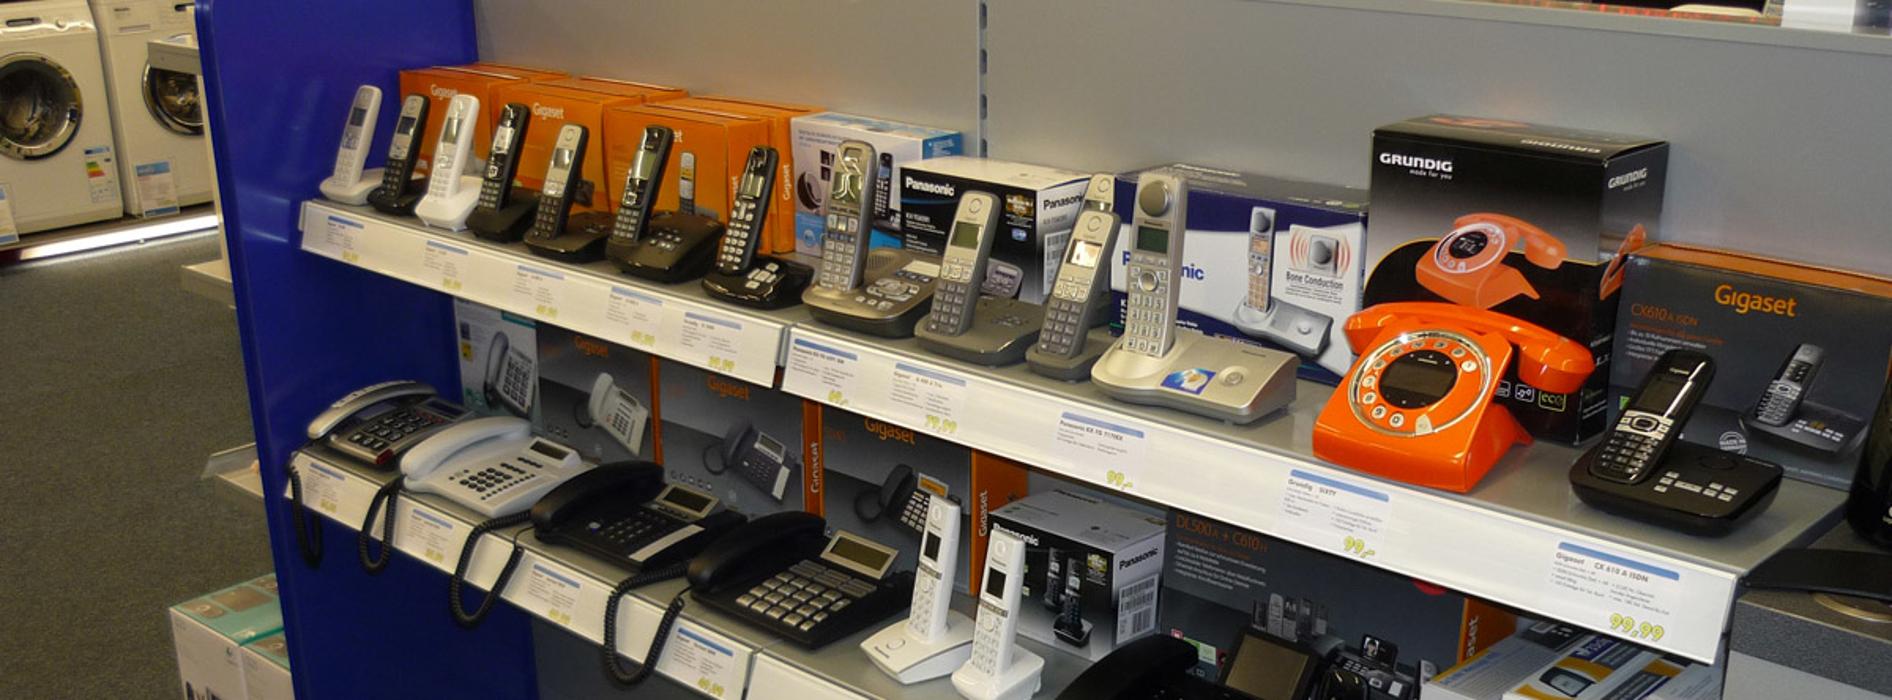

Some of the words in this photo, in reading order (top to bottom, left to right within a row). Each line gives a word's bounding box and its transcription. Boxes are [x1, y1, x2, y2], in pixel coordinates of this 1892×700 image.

[532, 102, 564, 120] Gigaset
[1379, 152, 1453, 172] GRUNDIG
[1409, 168, 1427, 177] made
[1427, 170, 1439, 178] for
[783, 164, 792, 200] Gigaset
[905, 176, 955, 197] Panasonic
[1608, 168, 1648, 189] GRUNDIG
[1286, 270, 1303, 284] Bone
[1304, 273, 1344, 290] Conduction
[1714, 283, 1797, 317] Gigaset
[707, 376, 750, 401] Gigaset
[864, 415, 916, 445] Gigaset
[810, 441, 819, 494] Gigaset
[1287, 478, 1313, 492] Grundig
[1319, 487, 1337, 497] SIXTY
[978, 489, 988, 538] Gigaset
[1119, 548, 1158, 571] Panasonic
[1556, 552, 1585, 566] Gigaset
[1628, 571, 1649, 583] ISDN
[1609, 612, 1665, 642] 99,99
